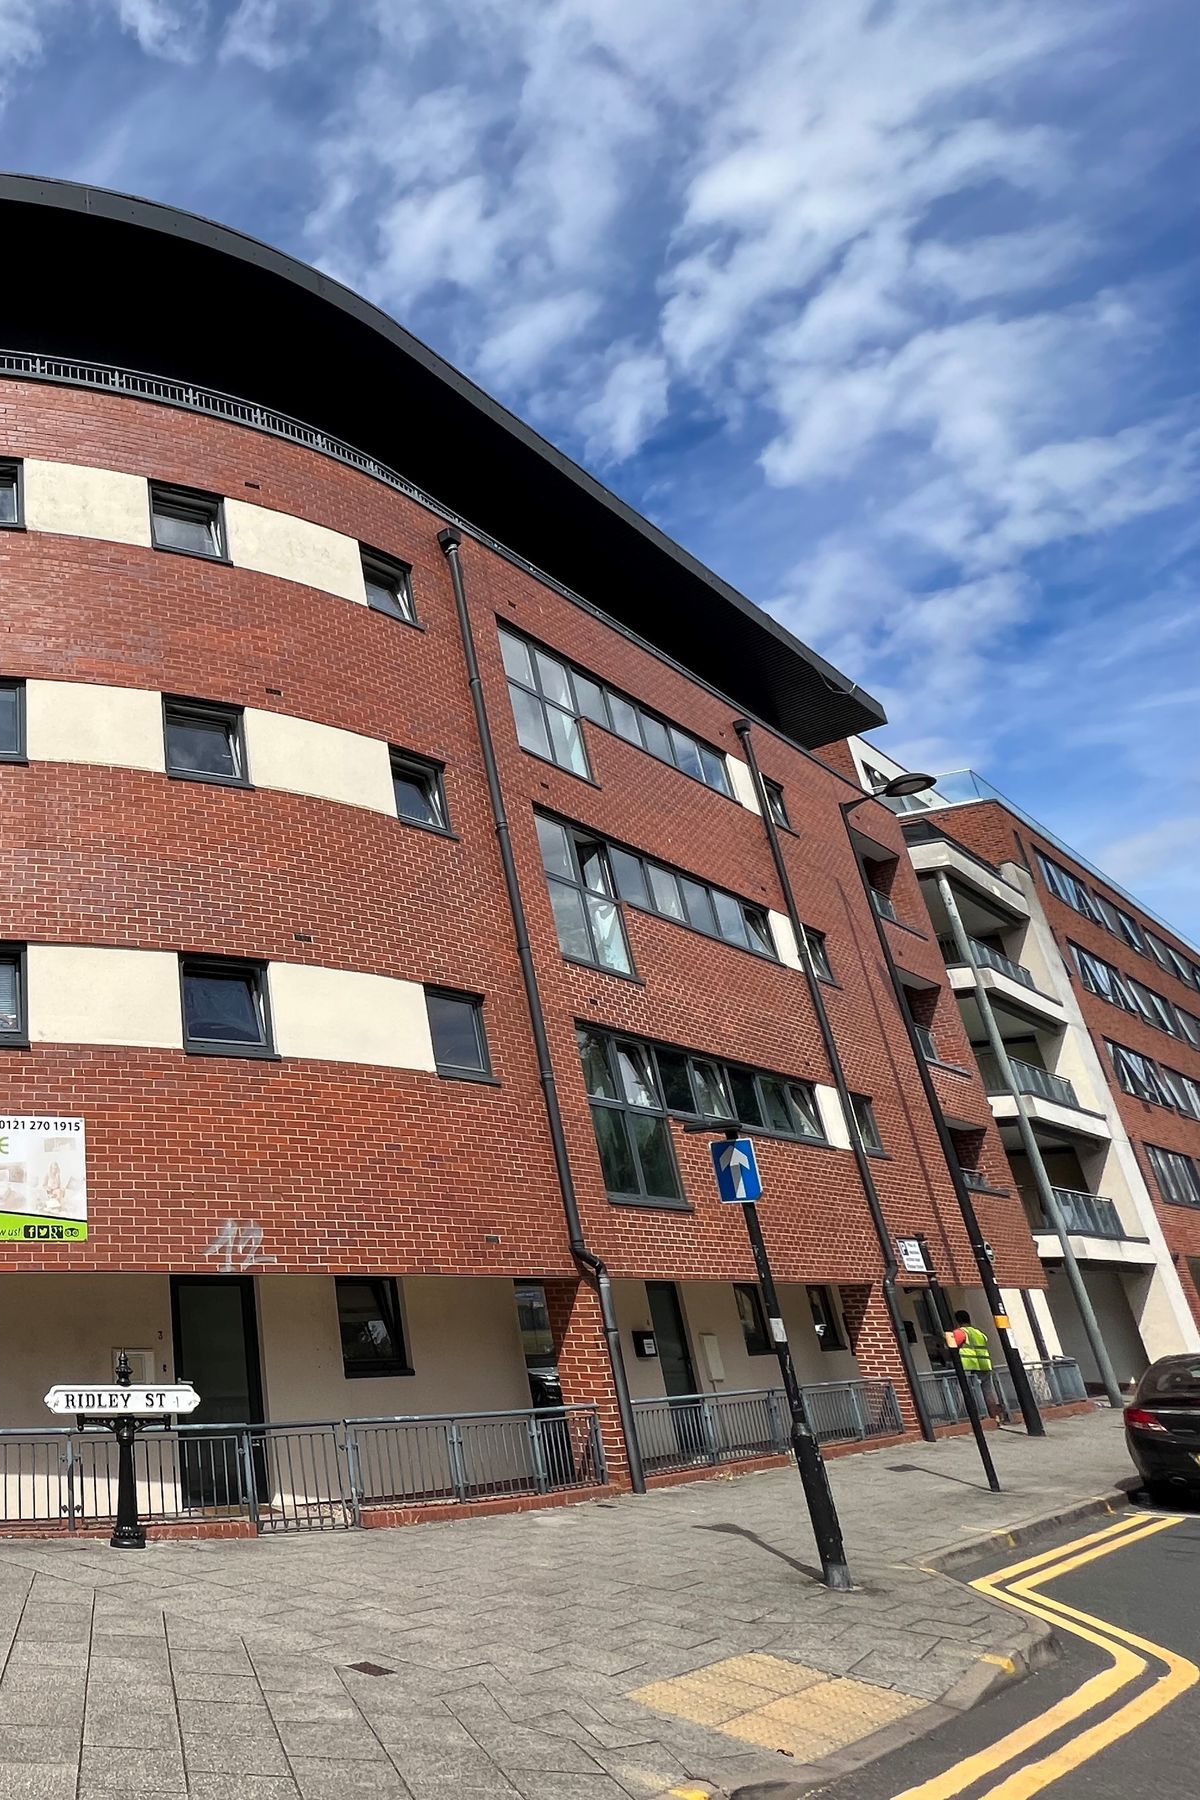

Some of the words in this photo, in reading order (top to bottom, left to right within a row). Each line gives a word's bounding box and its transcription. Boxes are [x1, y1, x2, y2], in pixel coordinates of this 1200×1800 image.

[29, 1120, 51, 1131] 270
[53, 1121, 81, 1132] 1915
[64, 1393, 132, 1409] RIDLEY
[145, 1392, 167, 1409] ST
